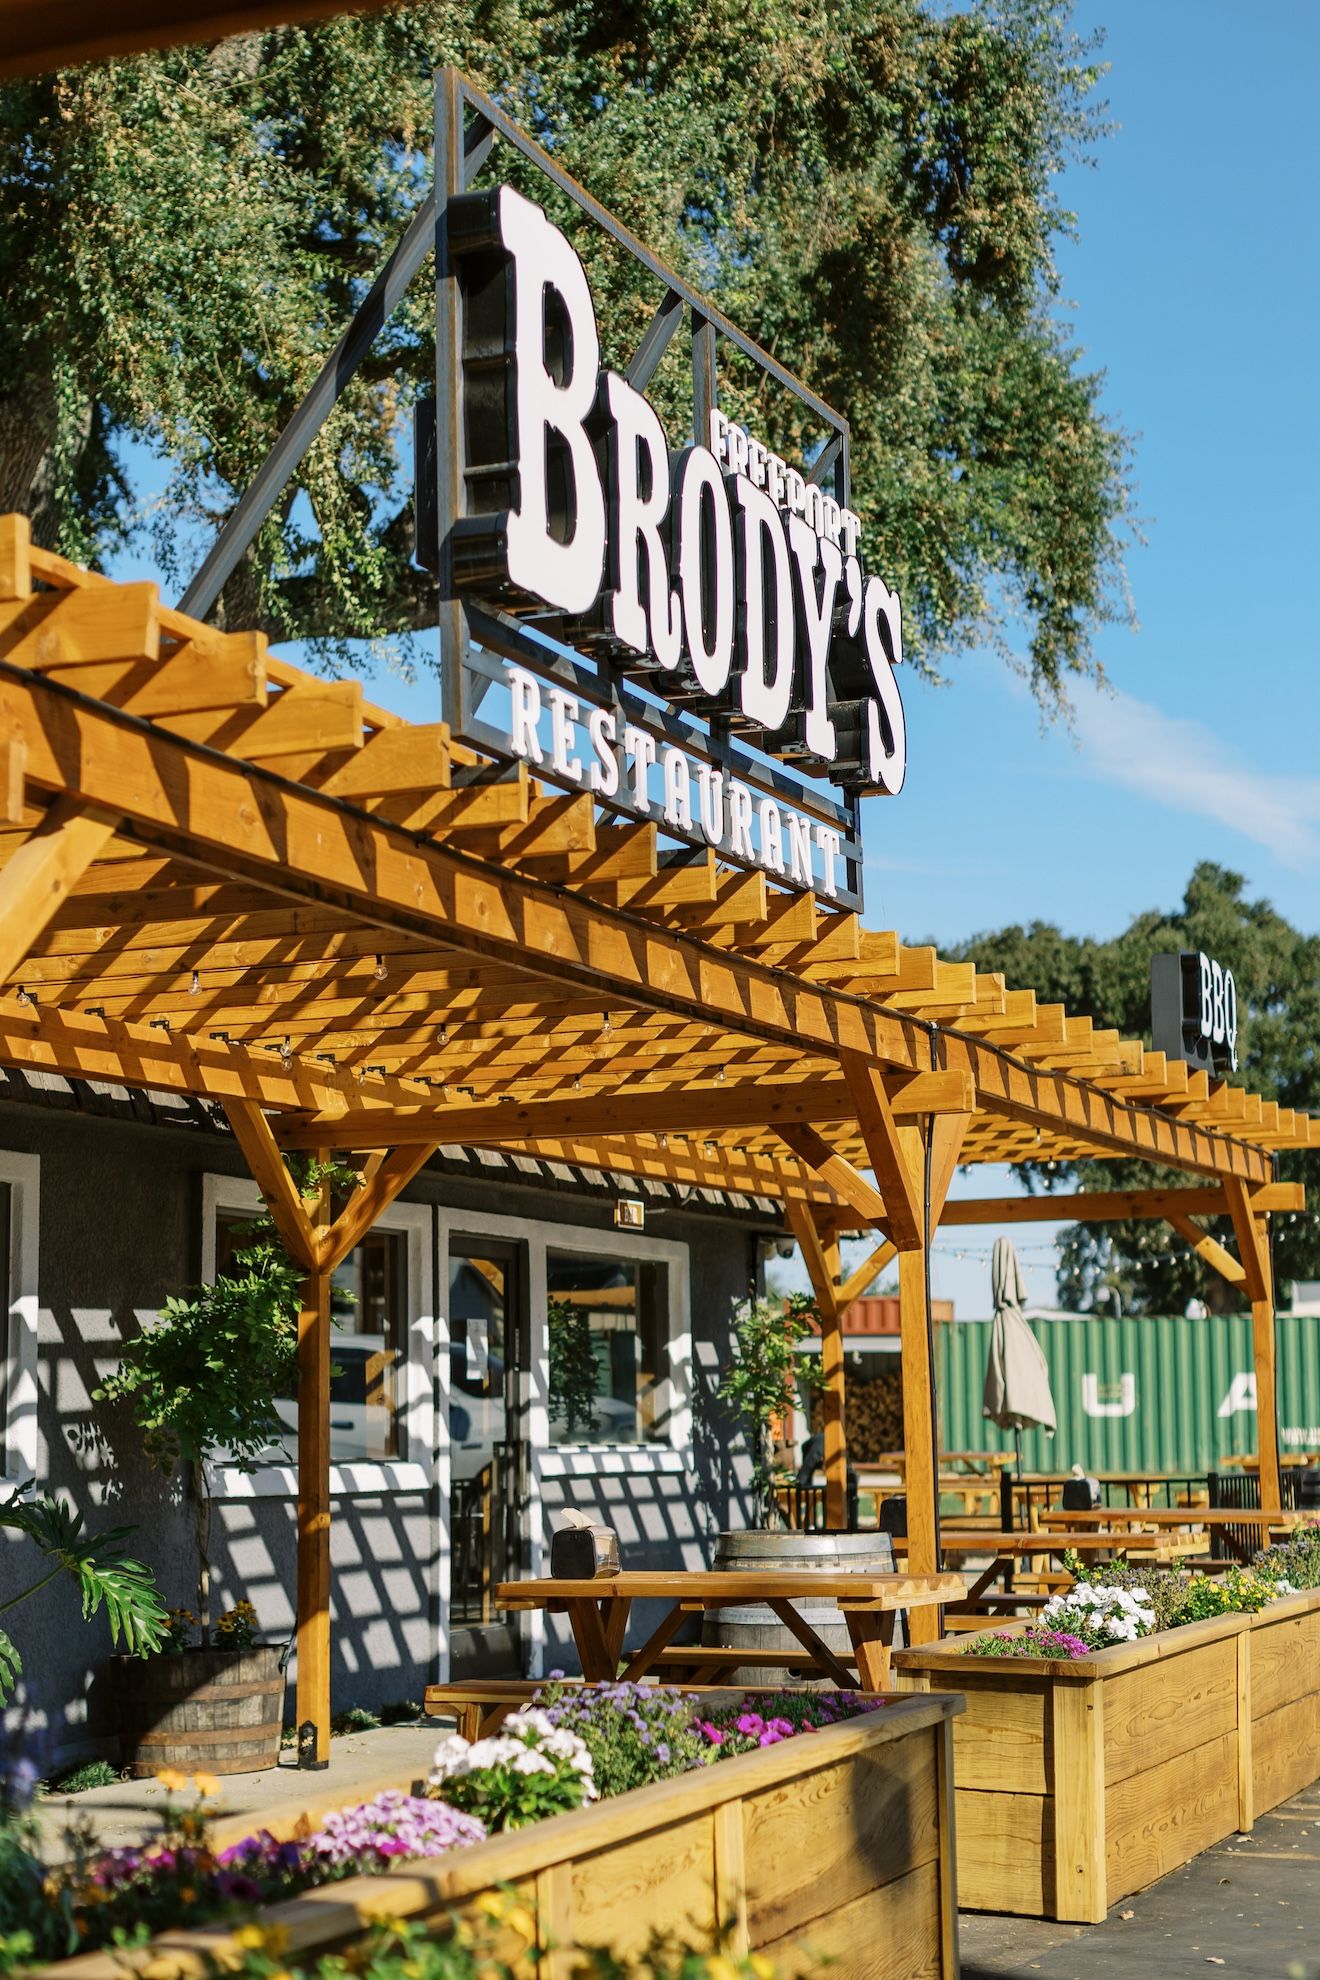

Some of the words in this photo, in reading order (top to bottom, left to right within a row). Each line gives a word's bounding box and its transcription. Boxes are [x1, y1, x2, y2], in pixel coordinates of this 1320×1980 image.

[499, 184, 906, 796] BRODY'S
[508, 667, 841, 898] RESTAURANT
[1199, 952, 1239, 1073] BBQ
